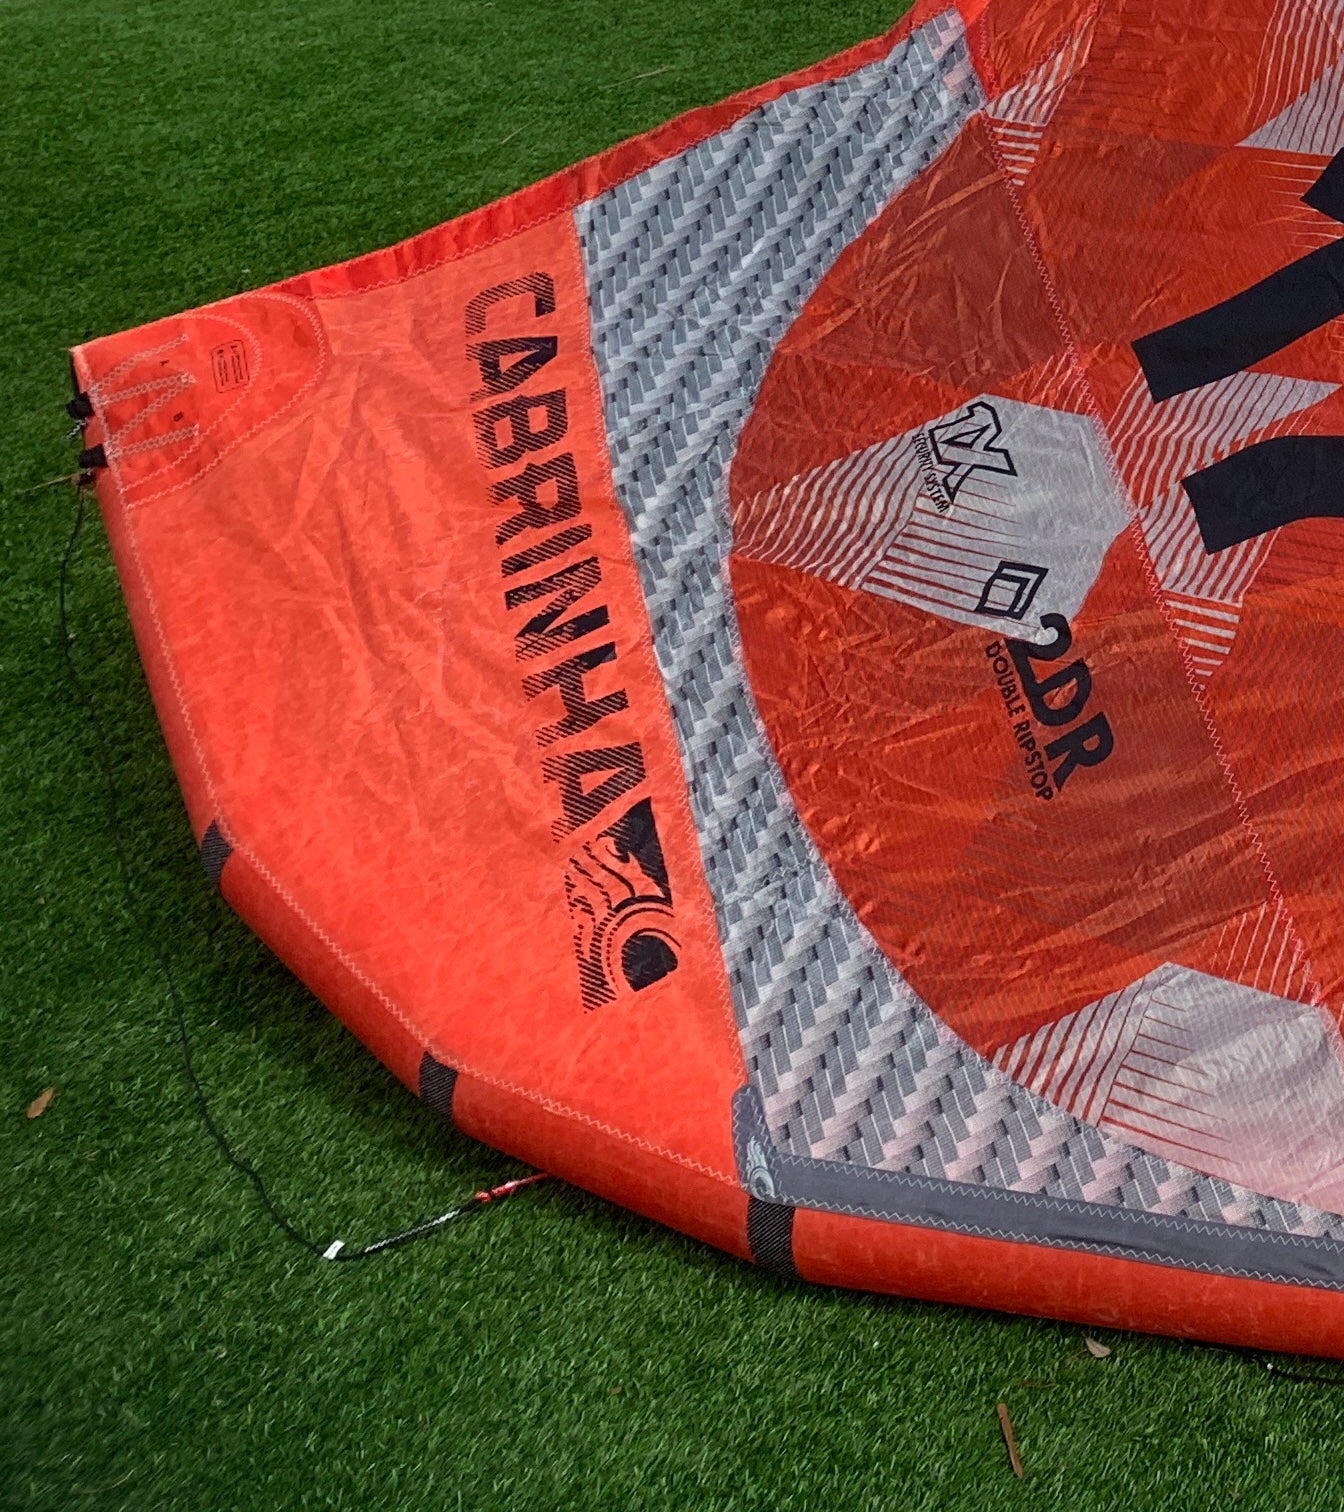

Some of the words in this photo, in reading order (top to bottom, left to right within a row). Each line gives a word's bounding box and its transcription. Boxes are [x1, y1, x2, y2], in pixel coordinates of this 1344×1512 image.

[462, 271, 651, 844] CABRINHA
[912, 432, 935, 473] SECURITY
[924, 473, 950, 514] SYSTEM
[985, 641, 1027, 719] DOUBLE
[1013, 721, 1054, 803] RIPSTOP
[1003, 613, 1114, 793] 2DR
